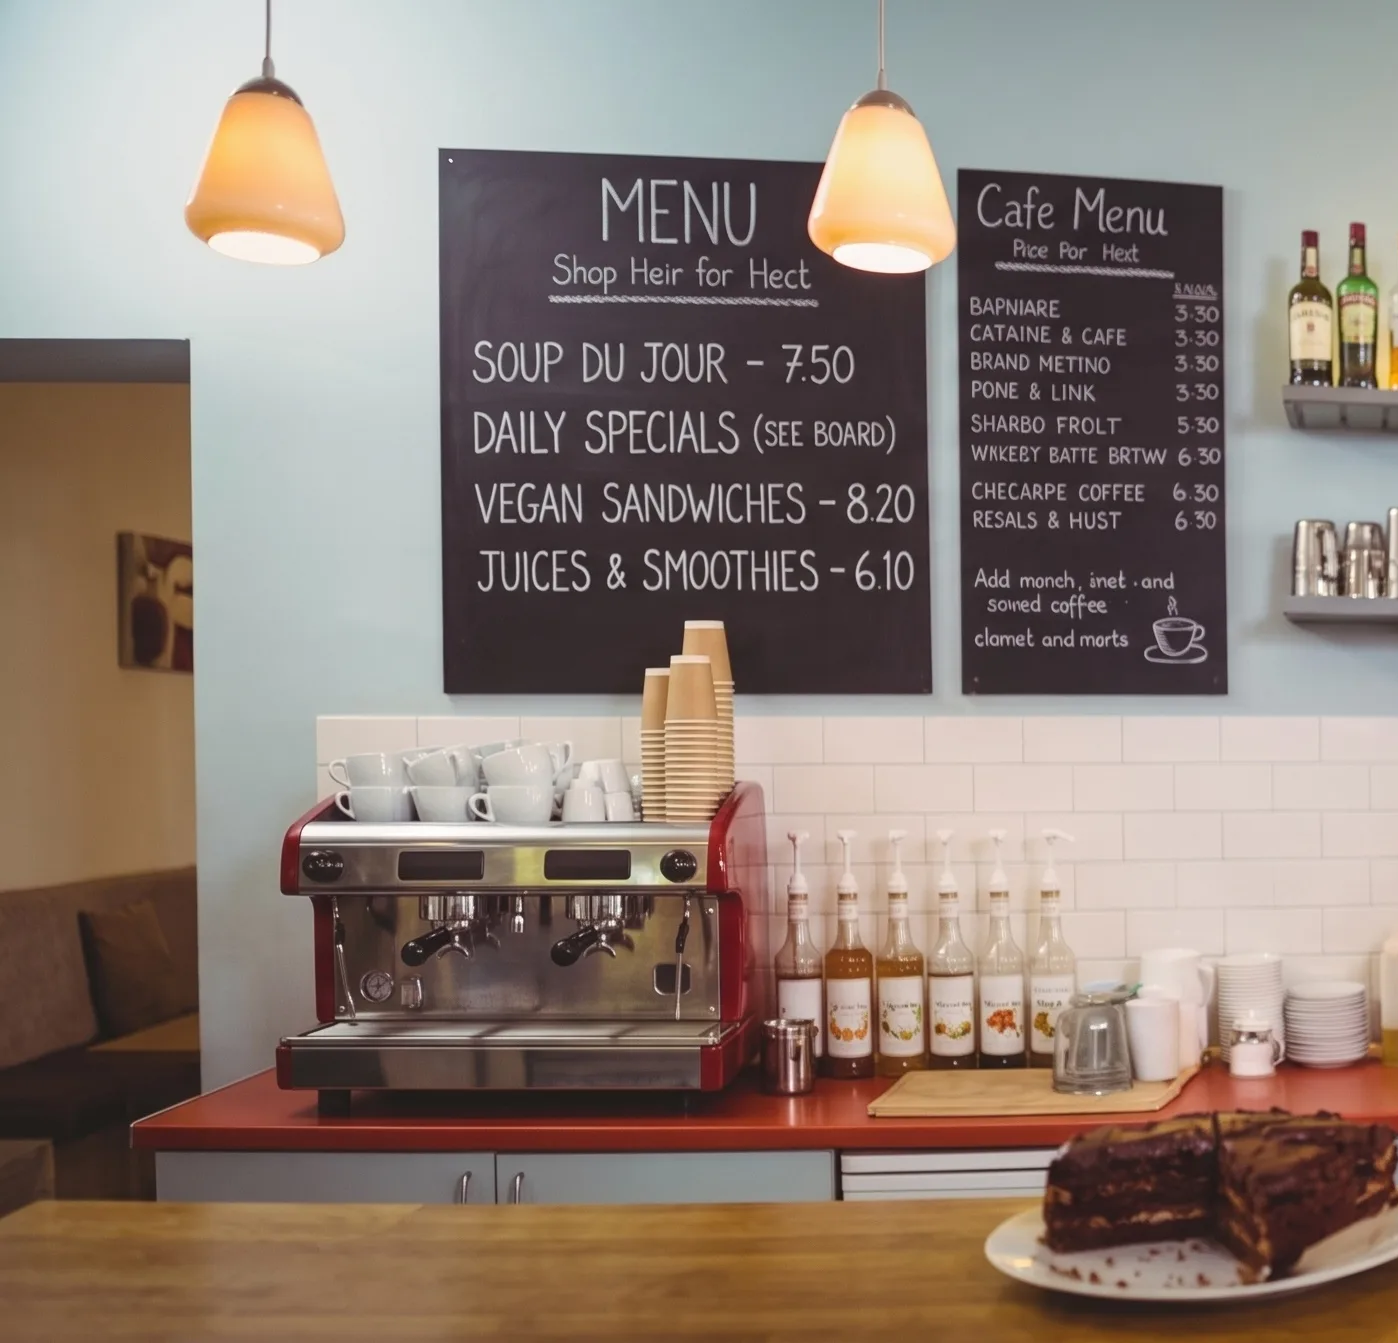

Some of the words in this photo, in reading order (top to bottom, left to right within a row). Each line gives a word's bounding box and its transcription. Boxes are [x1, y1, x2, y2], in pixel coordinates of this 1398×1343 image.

[601, 177, 757, 247] MENU
[977, 182, 1054, 229] Cafe
[1073, 186, 1169, 236] Menu
[1060, 241, 1088, 260] Por
[1103, 243, 1140, 263] Hext
[552, 253, 618, 295] Shop
[630, 256, 683, 287] Heir
[696, 256, 733, 287] for
[749, 257, 812, 290] Hect
[969, 296, 1061, 319] BAPNIARE
[970, 324, 1052, 344] CATAINE
[1062, 326, 1073, 345] &
[1081, 327, 1127, 347] CAFE
[472, 340, 564, 384] SOUP
[583, 341, 625, 384] DU
[640, 341, 728, 385] JOUR
[781, 344, 855, 385] 7.50
[970, 351, 1031, 372] BRAND
[1039, 354, 1111, 375] METINO
[971, 379, 1019, 400] PONE
[1029, 381, 1041, 401] &
[1051, 383, 1096, 402] LINK
[474, 410, 567, 455] DAILY
[585, 410, 740, 455] SPECIALS
[753, 413, 804, 455] (SEE
[813, 415, 896, 455] BOARD)
[970, 413, 1046, 434] SHARBO
[1056, 415, 1122, 435] FROLT
[1049, 446, 1098, 465] BATTE
[474, 482, 583, 524] VEGAN
[601, 481, 807, 525] SANDWICHES
[846, 482, 916, 525] 8.20
[971, 481, 1067, 502] CHECARPE
[1078, 483, 1145, 503] COFFEE
[972, 509, 1038, 530] RESALS
[1047, 510, 1060, 530] &
[1069, 511, 1122, 530] HUST
[477, 549, 591, 593] JUICES
[606, 552, 627, 590] &
[642, 548, 819, 592] SMOOTHIES
[855, 550, 915, 592] 6.10
[974, 567, 1011, 589] Add
[1050, 593, 1108, 620] coffee
[1041, 628, 1075, 648] and
[1079, 629, 1129, 648] morts
